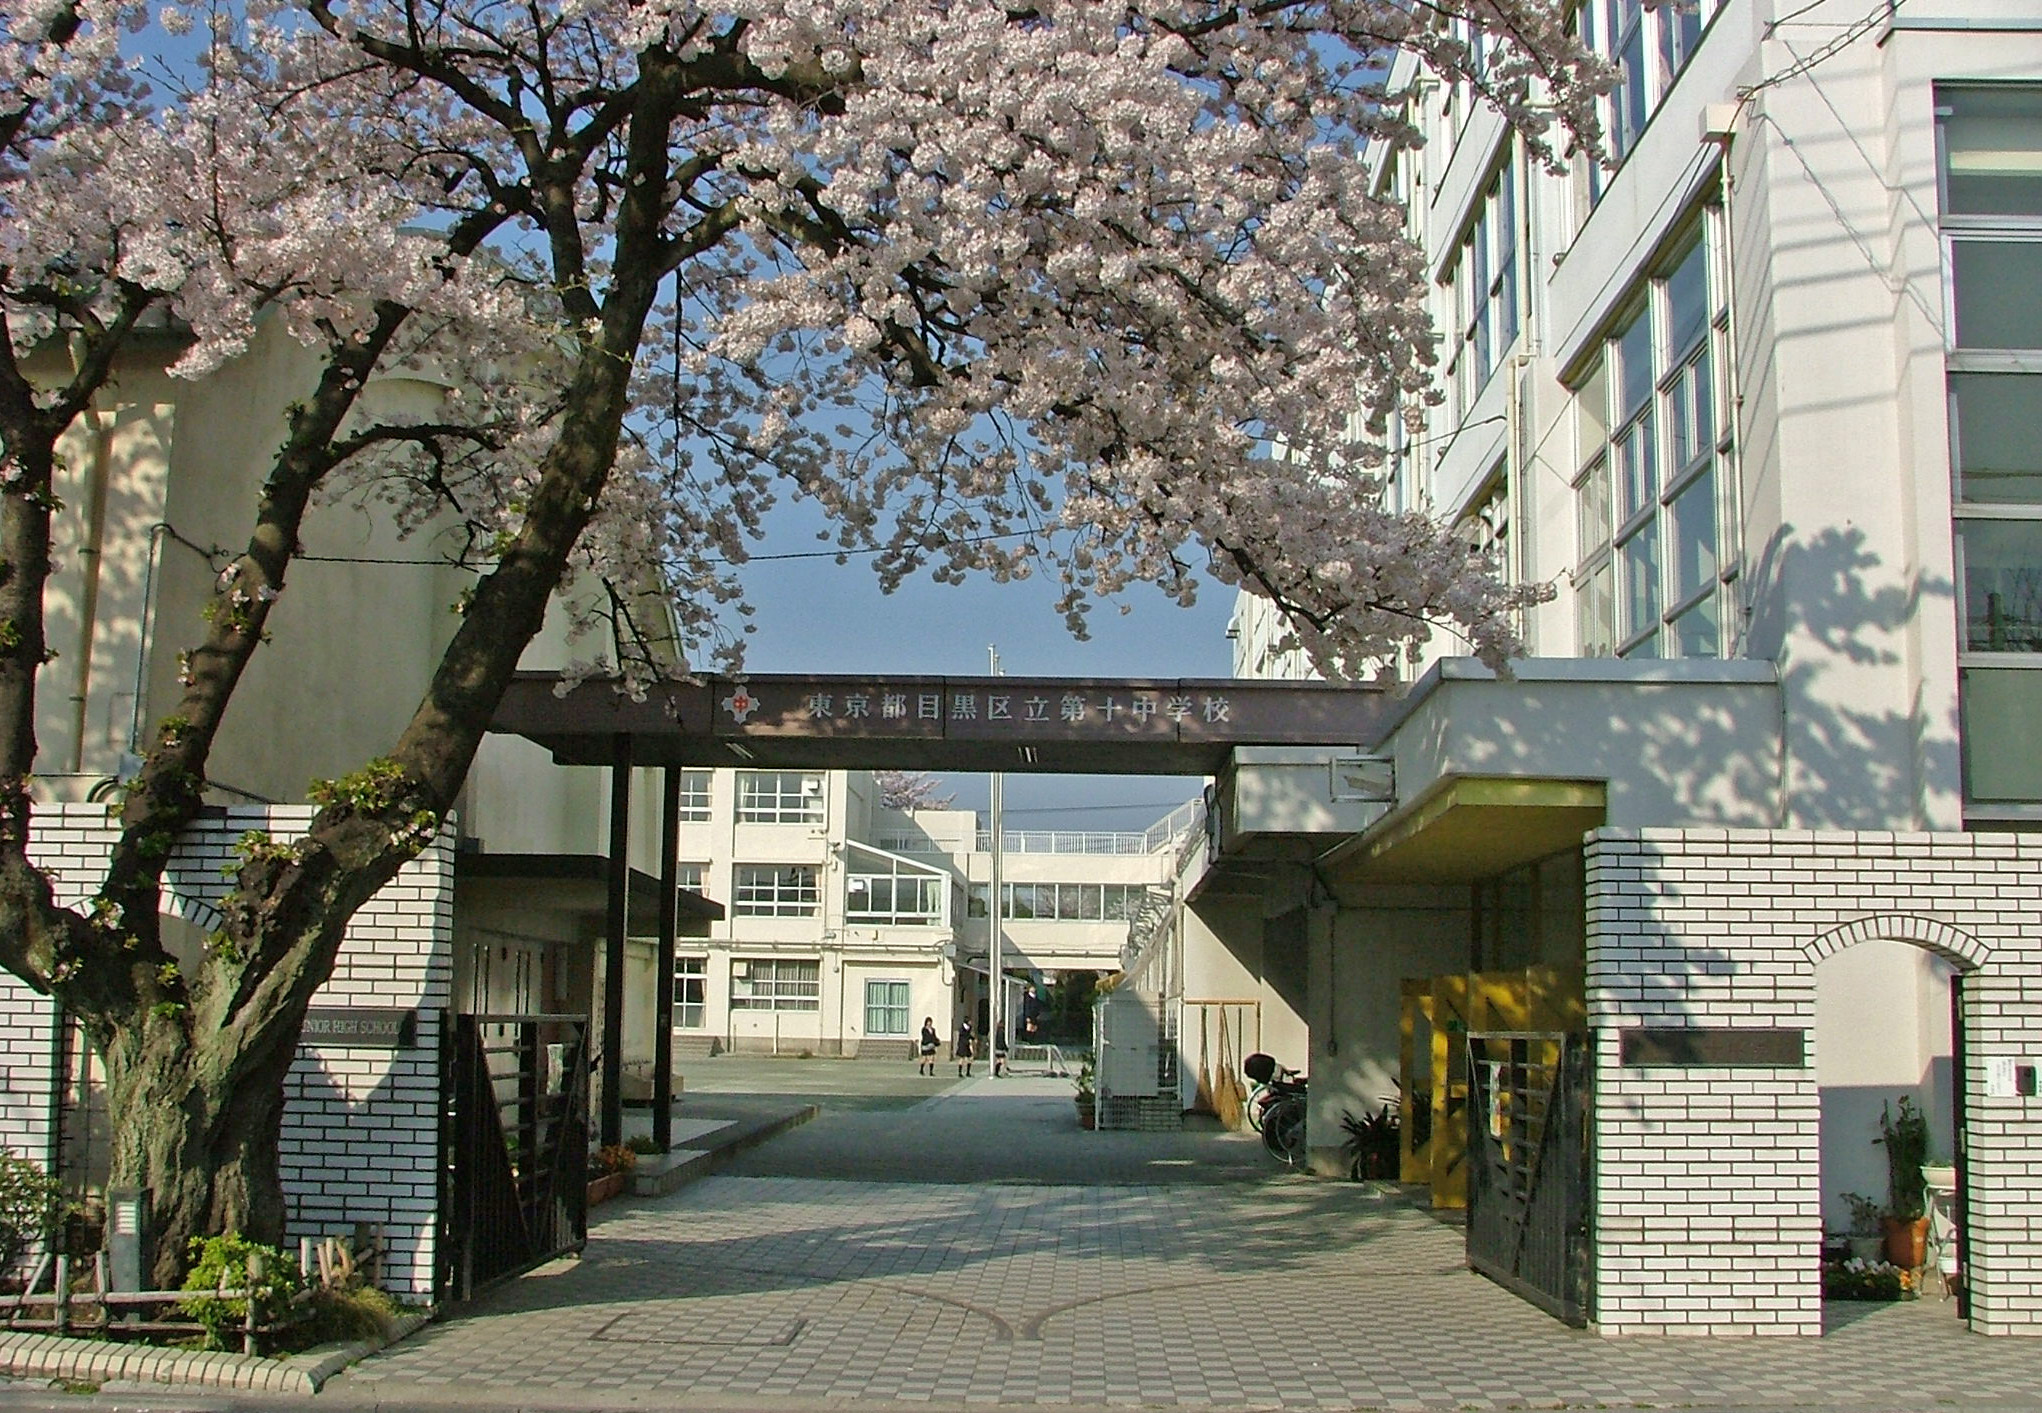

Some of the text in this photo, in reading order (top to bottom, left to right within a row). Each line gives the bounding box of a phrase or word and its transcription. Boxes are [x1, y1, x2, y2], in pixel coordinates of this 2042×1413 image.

[808, 692, 1230, 723] 東京都目黒区立第十中学校
[333, 1019, 357, 1034] HIGH
[360, 1020, 399, 1035] SCHOOL
